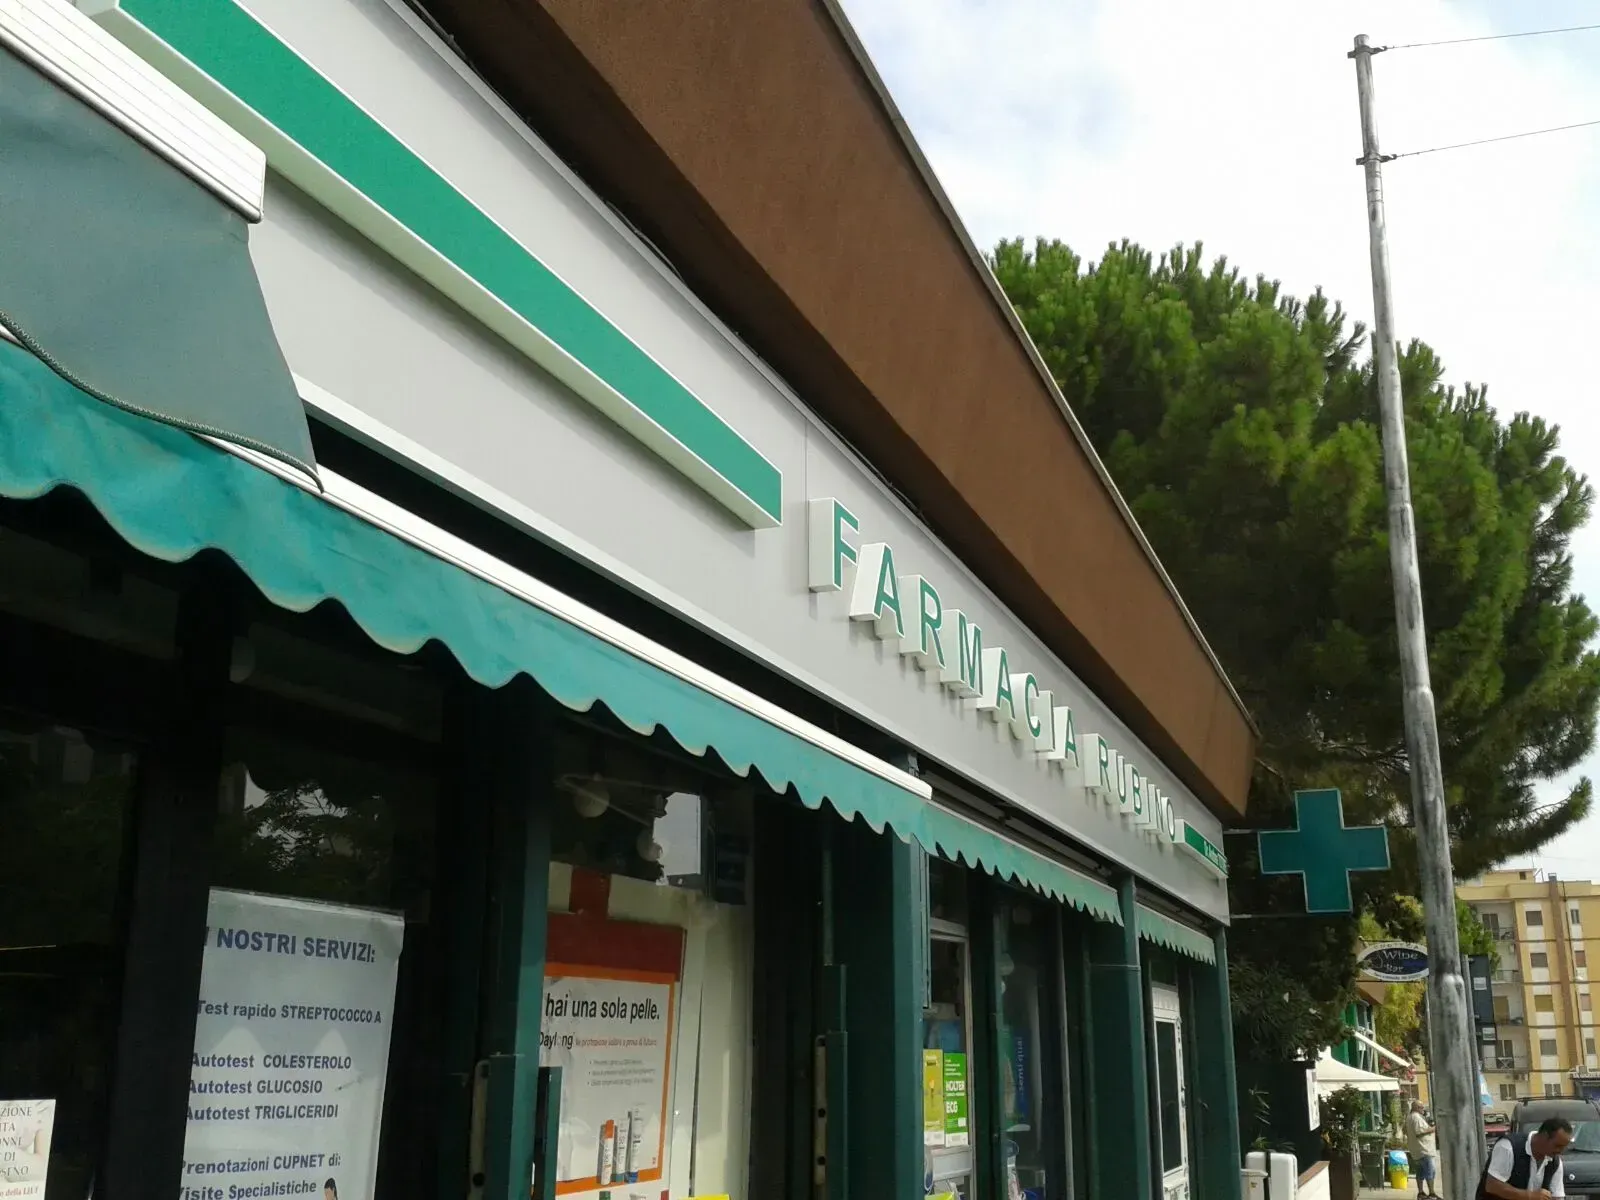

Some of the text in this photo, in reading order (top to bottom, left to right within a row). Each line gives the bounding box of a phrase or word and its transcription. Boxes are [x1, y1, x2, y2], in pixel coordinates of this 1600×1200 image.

[811, 497, 1176, 842] FARMACIA RUBINO
[217, 927, 297, 955] NOSTRI
[303, 937, 376, 963] SERVIZI:
[198, 1000, 382, 1023] Test rapido STREPTOCOCCO A
[545, 993, 660, 1024] hai una sola pelle.
[192, 1053, 352, 1069] Autotest COLESTEROLO
[188, 1080, 323, 1094] Autotest GLUCOSIO
[186, 1104, 339, 1120] Autotest TRIGLICERIDI
[273, 1154, 325, 1170] CUPNET
[329, 1153, 341, 1167] di:
[229, 1180, 317, 1200] Specialistiche
